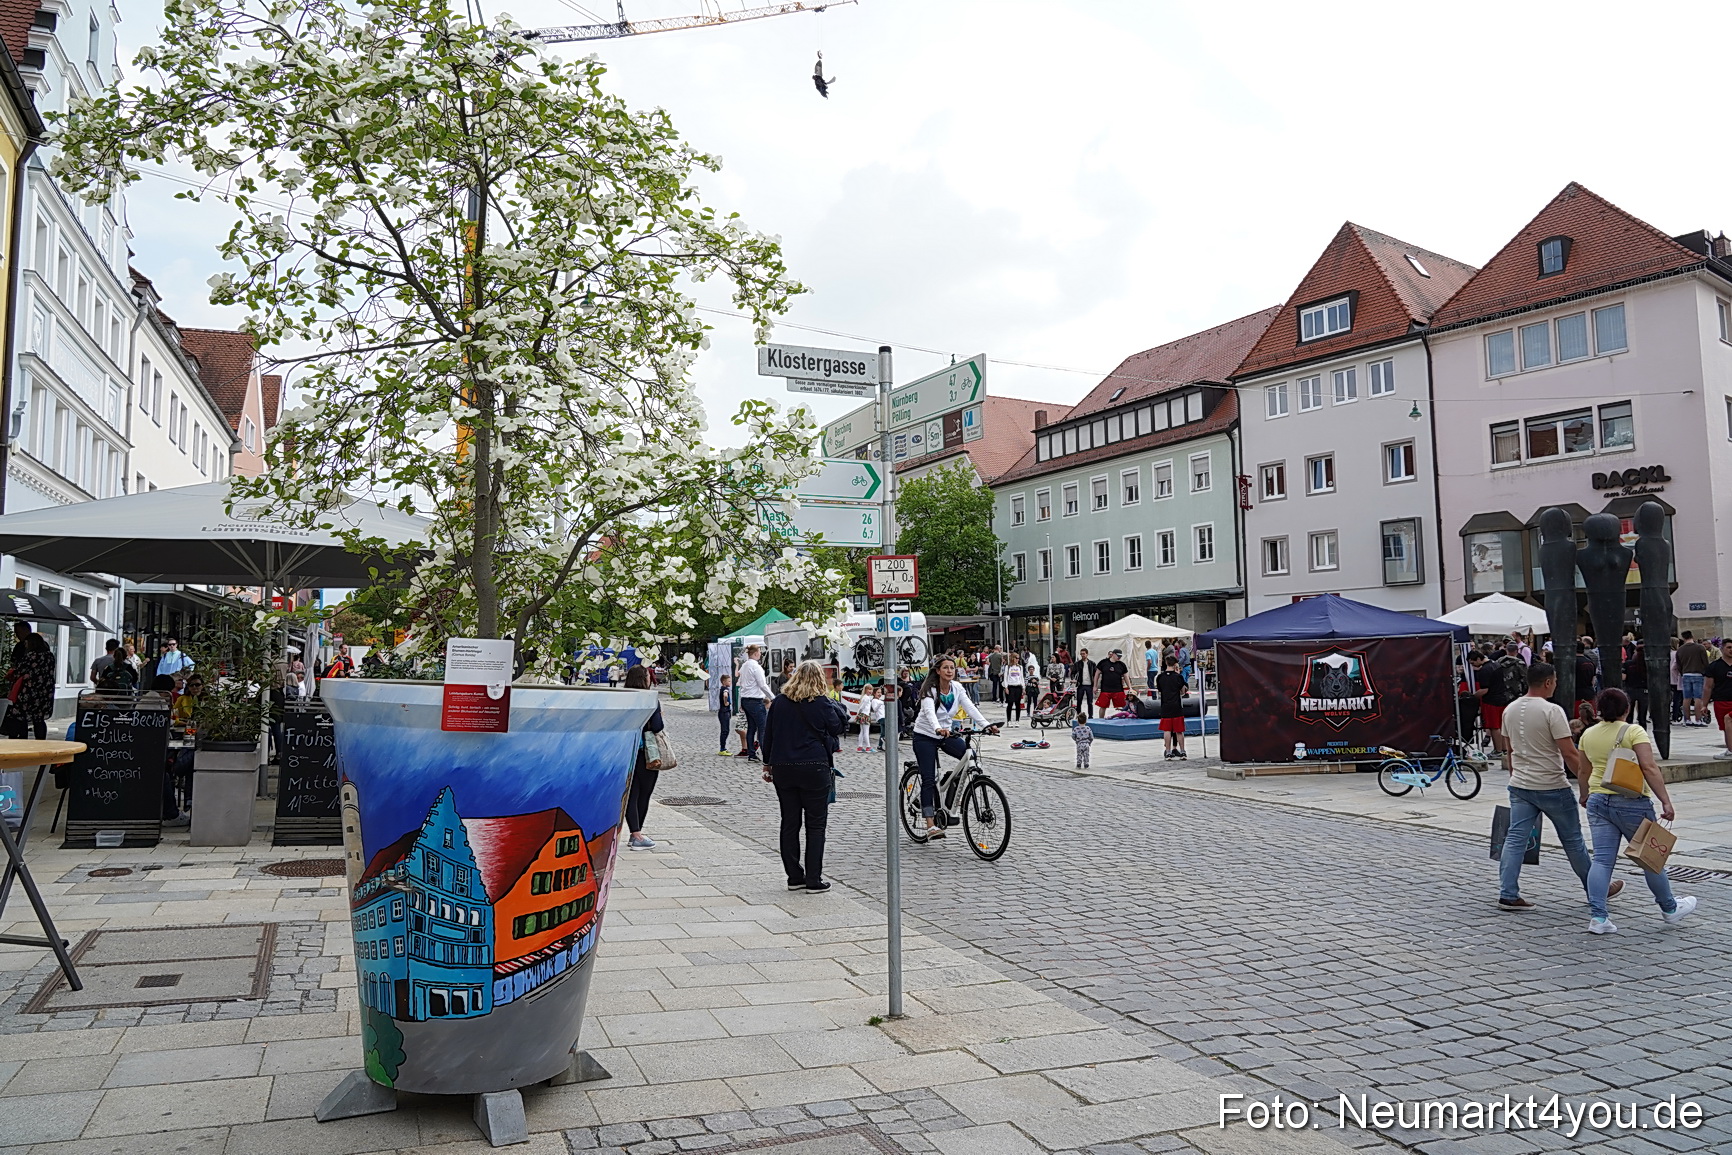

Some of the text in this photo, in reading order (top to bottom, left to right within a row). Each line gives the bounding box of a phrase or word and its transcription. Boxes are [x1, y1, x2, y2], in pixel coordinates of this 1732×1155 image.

[768, 348, 866, 377] Klostergasse
[949, 374, 956, 386] 47
[892, 392, 918, 409] Nürnberg
[892, 409, 911, 423] Pölling
[1592, 465, 1672, 490] RACKL
[1621, 486, 1664, 496] Rathaus
[862, 514, 872, 524] 26
[201, 526, 310, 537] Lammsbräu
[874, 560, 905, 569] H 200
[1072, 612, 1099, 621] Fielmann
[1300, 695, 1374, 712] NEUMARKT
[82, 710, 110, 728] Eis
[98, 728, 134, 744] Lillet
[285, 728, 335, 747] Frühs
[96, 748, 134, 765] Aperol
[1307, 747, 1377, 755] WAPPENWUNDER.DE
[94, 767, 141, 783] Campari
[92, 788, 118, 804] Hugo
